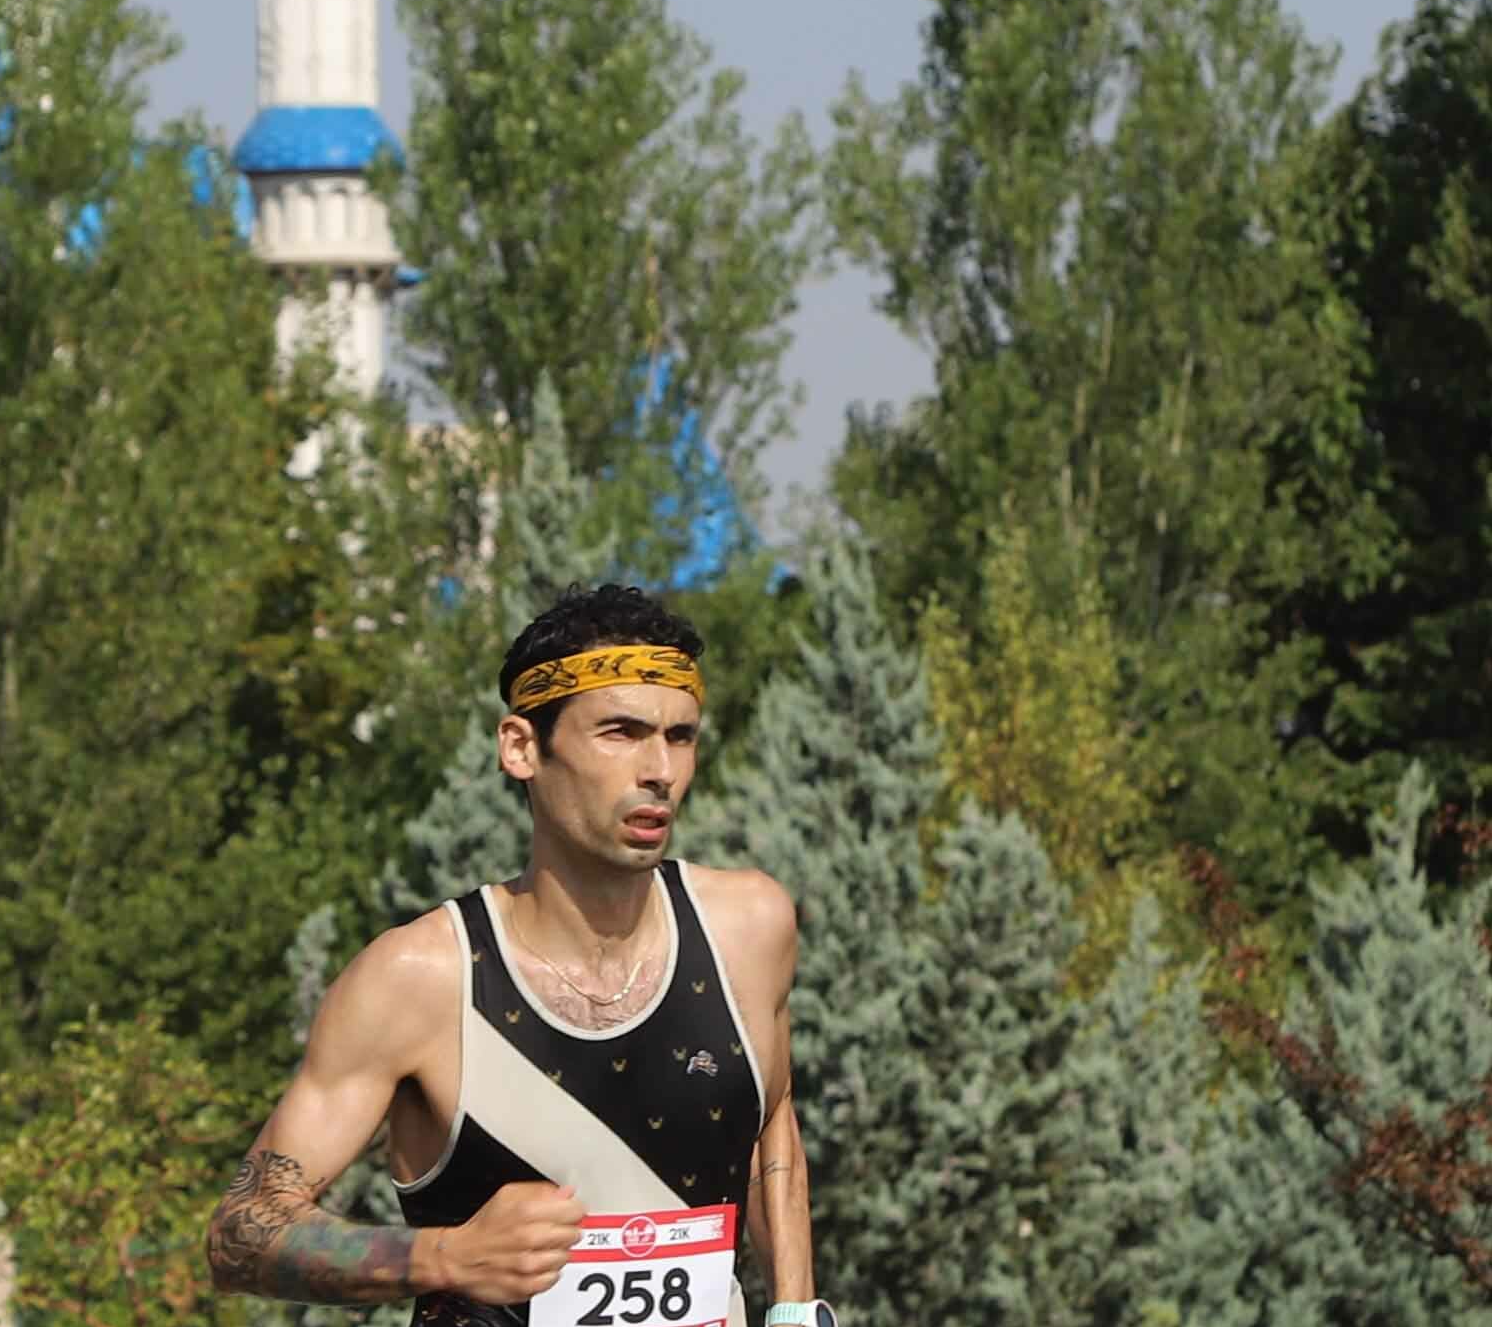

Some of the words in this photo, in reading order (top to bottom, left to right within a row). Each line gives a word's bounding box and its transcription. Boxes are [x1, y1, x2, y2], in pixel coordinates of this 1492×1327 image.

[587, 1232, 611, 1246] 21K
[669, 1226, 691, 1241] 21K
[575, 1267, 692, 1326] 258
